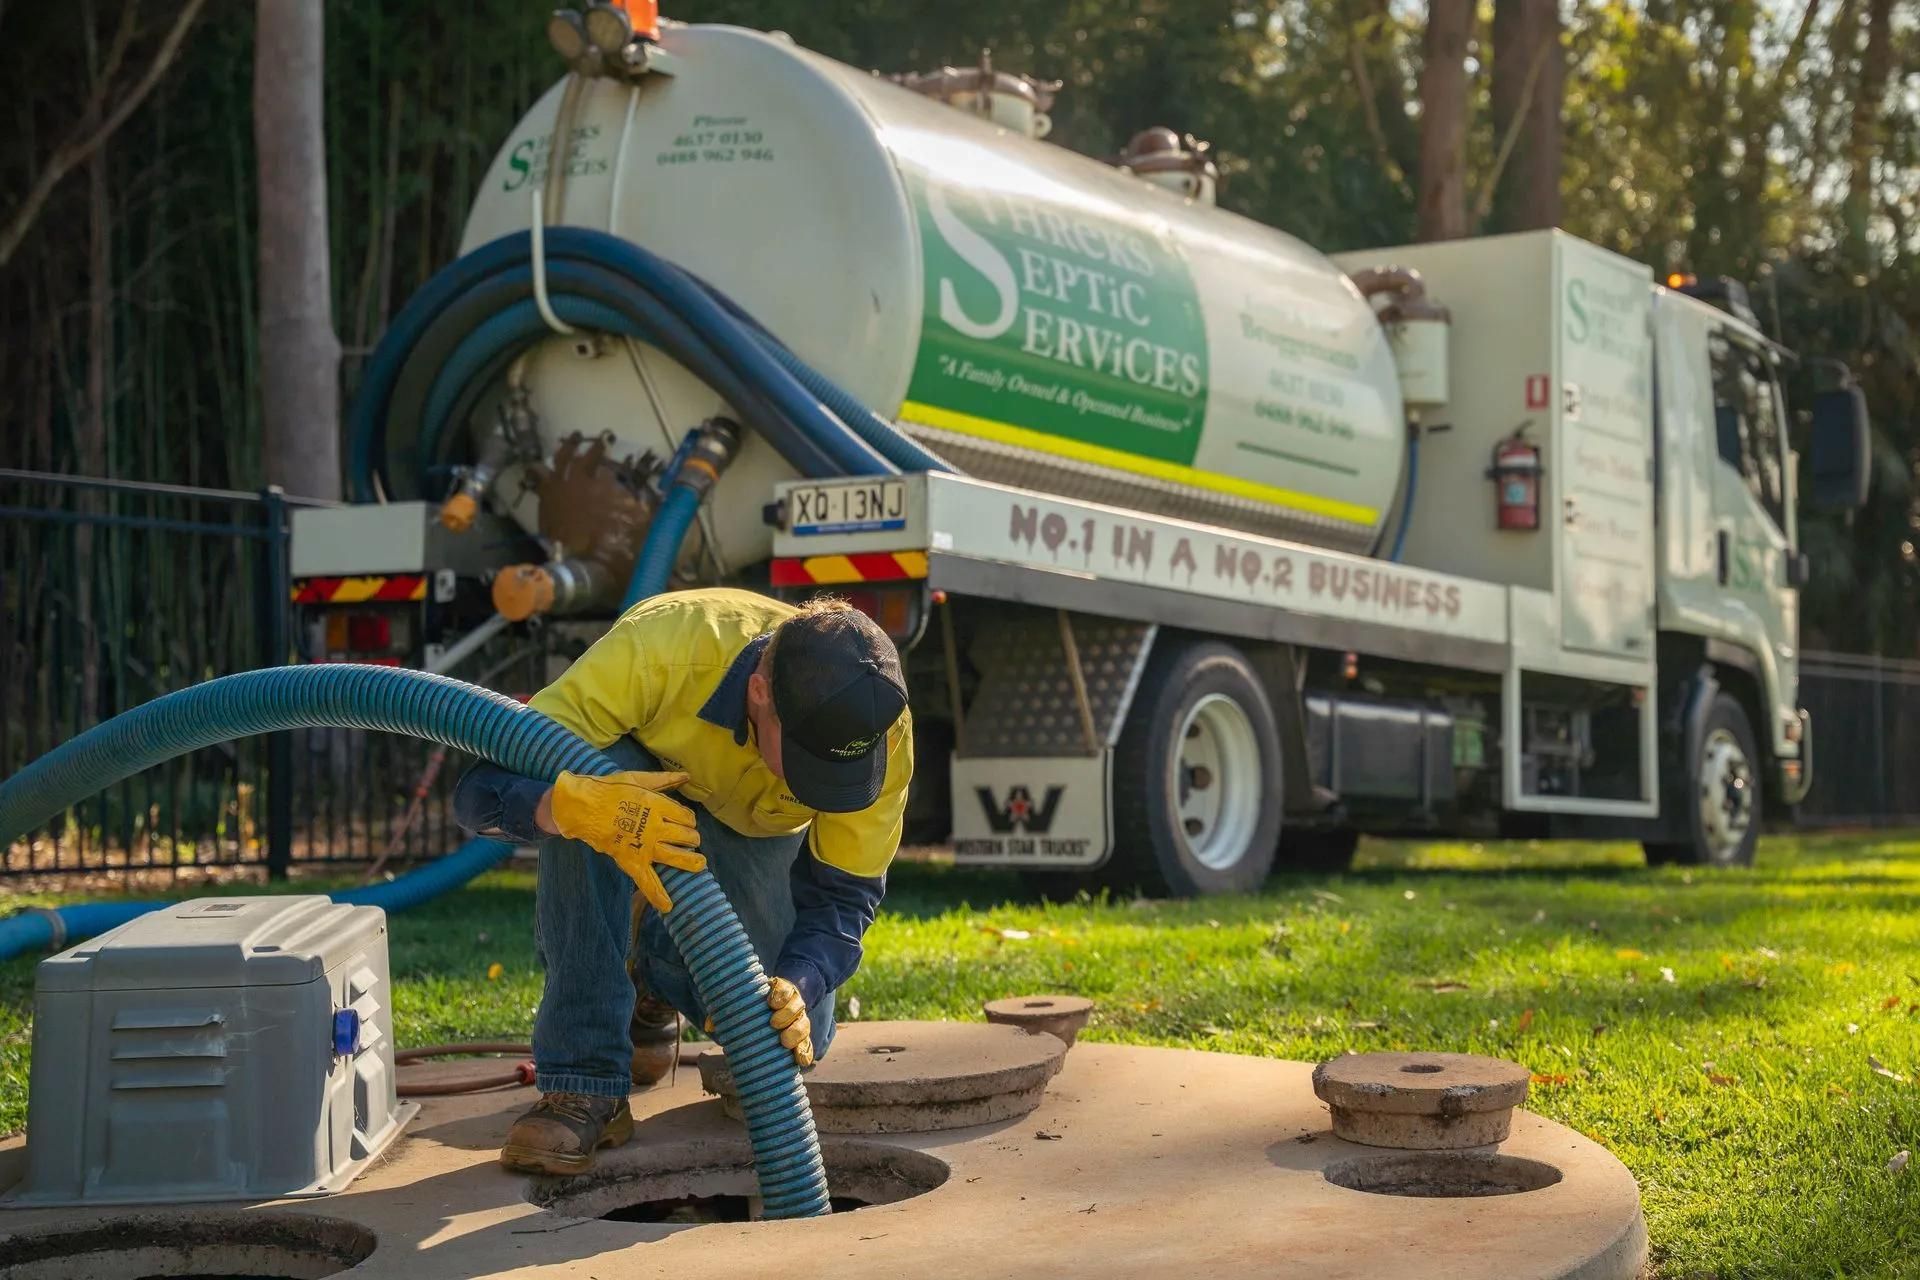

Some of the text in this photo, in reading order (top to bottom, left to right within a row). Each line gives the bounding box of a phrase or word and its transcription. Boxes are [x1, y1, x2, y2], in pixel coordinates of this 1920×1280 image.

[957, 361, 1004, 391] Family
[1007, 374, 1056, 404] Owned
[1010, 504, 1462, 616] NO.1 IN A NO.2 BUSINESS
[635, 807, 650, 840] TROJAN
